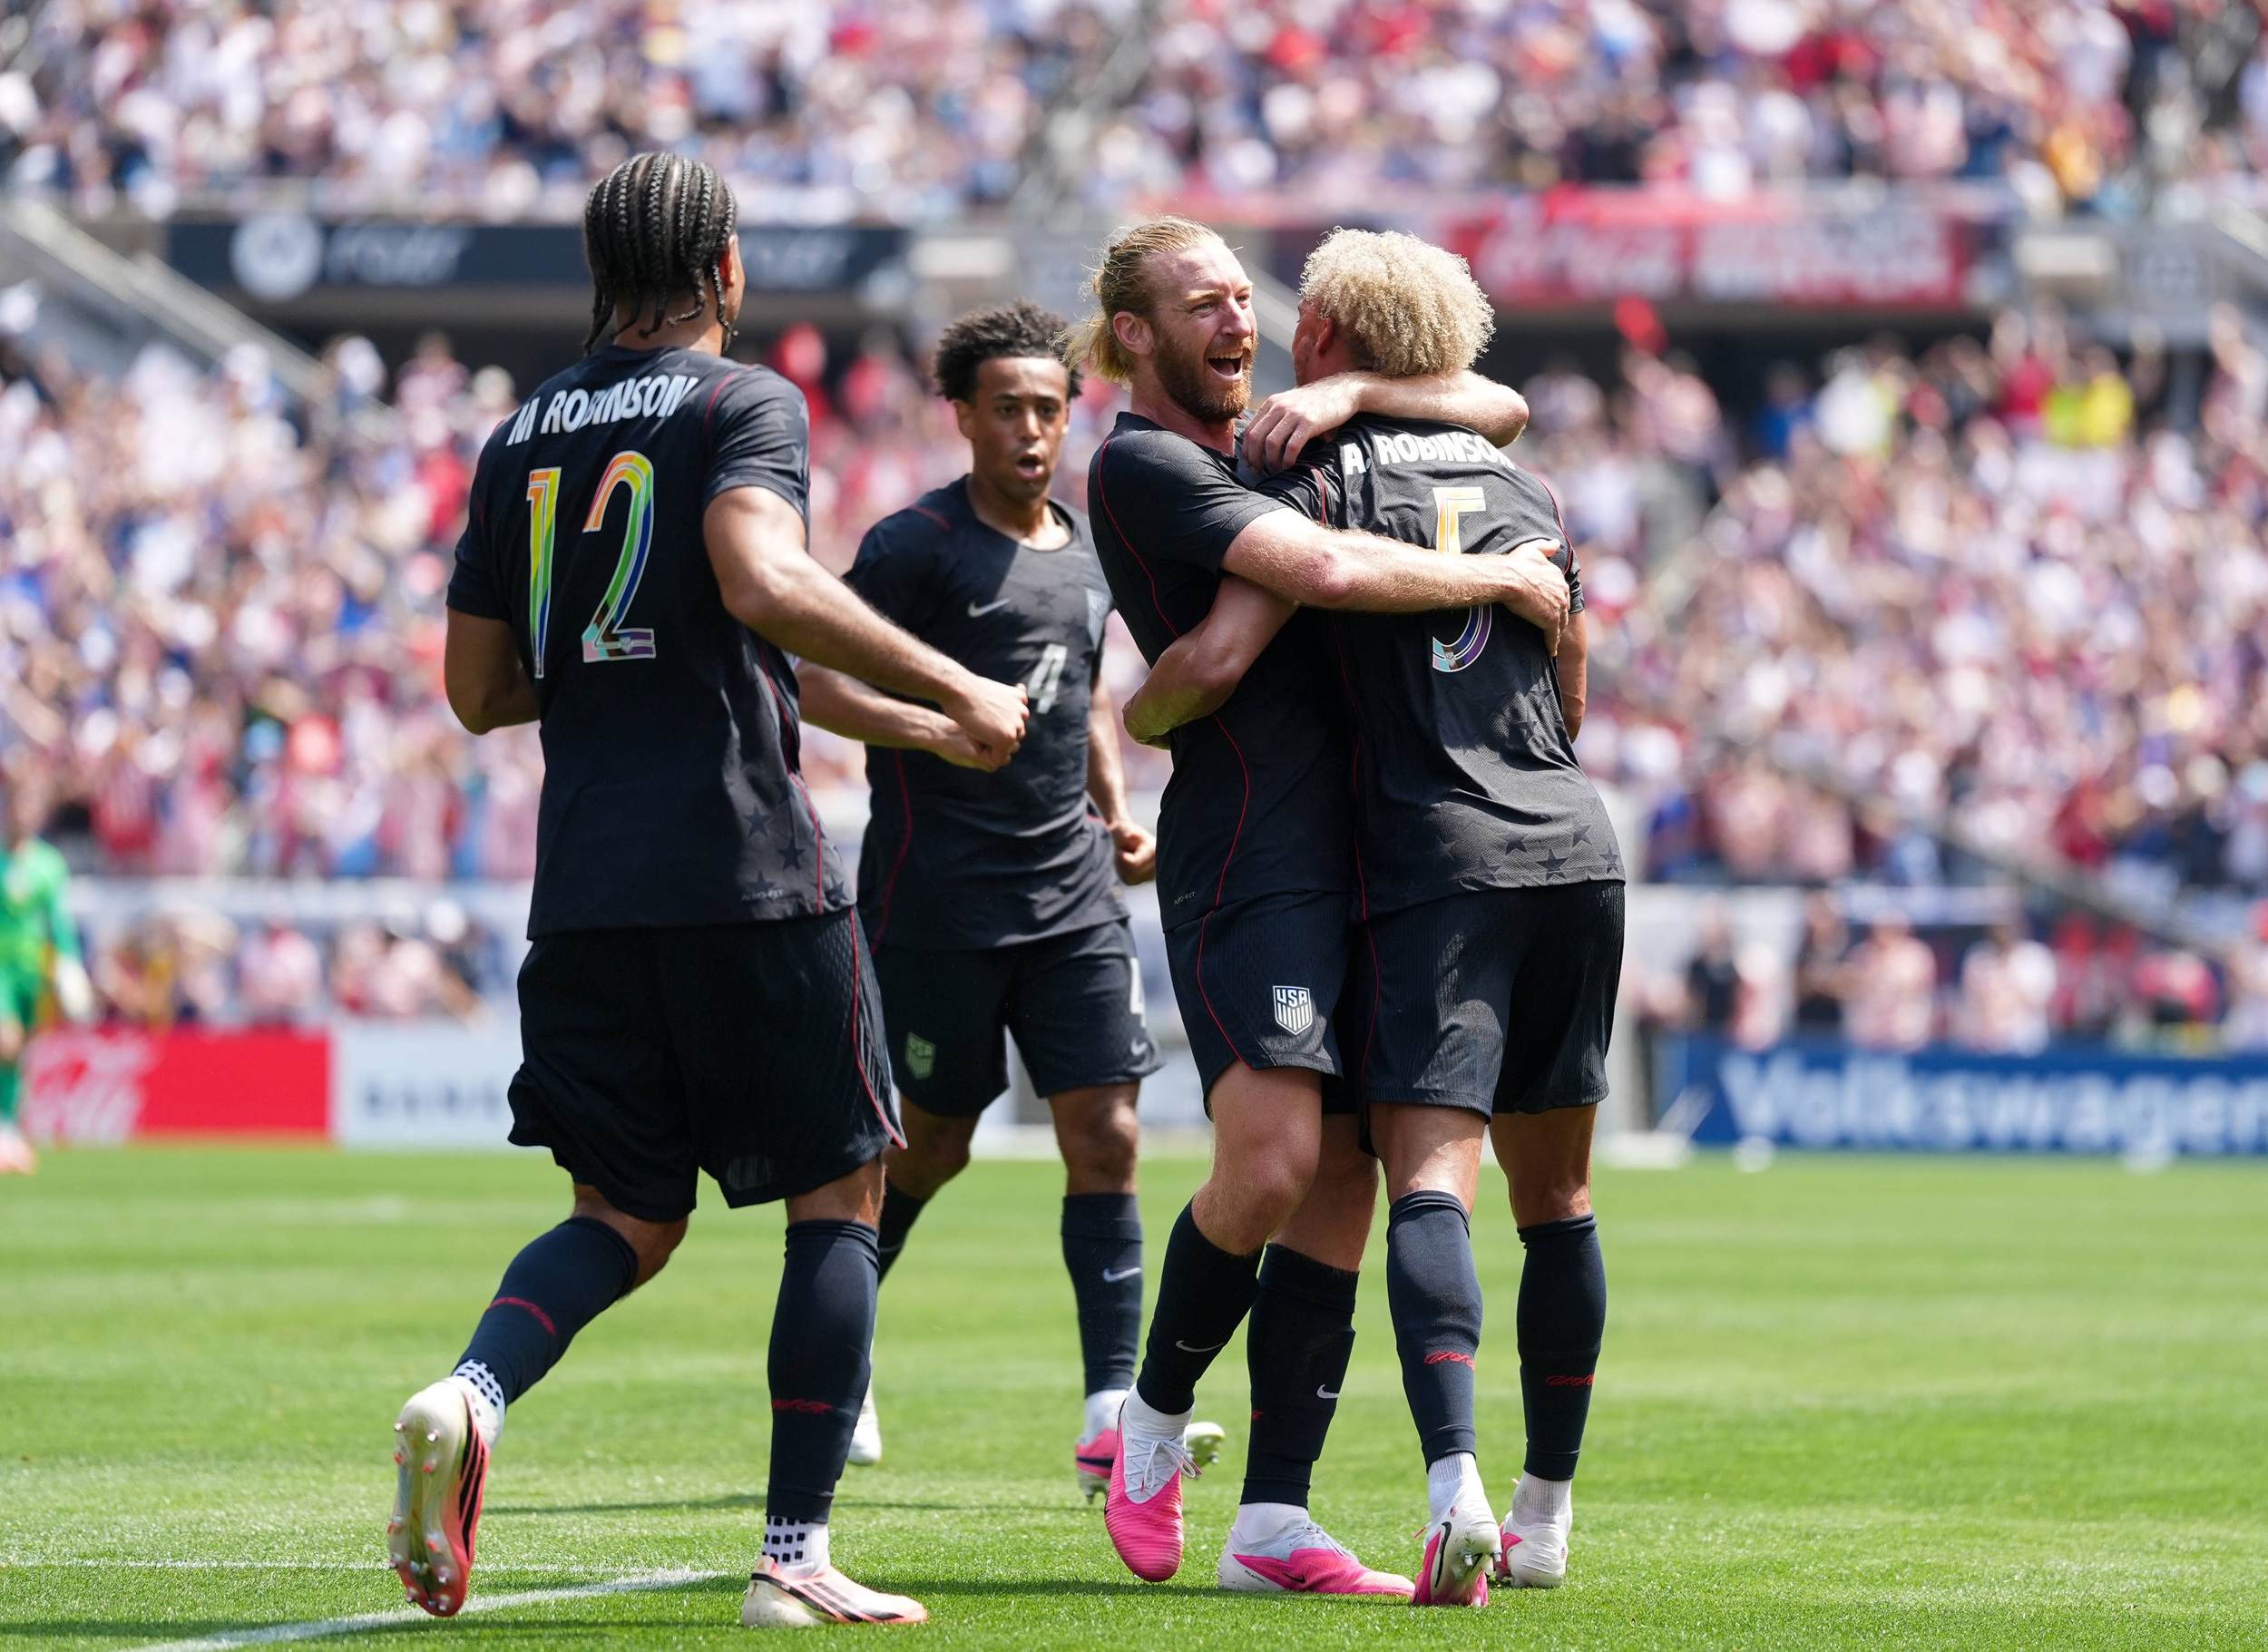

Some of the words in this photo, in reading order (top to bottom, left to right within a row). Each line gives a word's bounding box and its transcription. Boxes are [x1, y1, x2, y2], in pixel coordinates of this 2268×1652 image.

[506, 396, 541, 446] M
[540, 374, 699, 435] ROBINSON
[526, 450, 657, 679] 12
[1432, 486, 1492, 672] 5
[1027, 643, 1068, 714] 4
[1276, 988, 1308, 1008] USA
